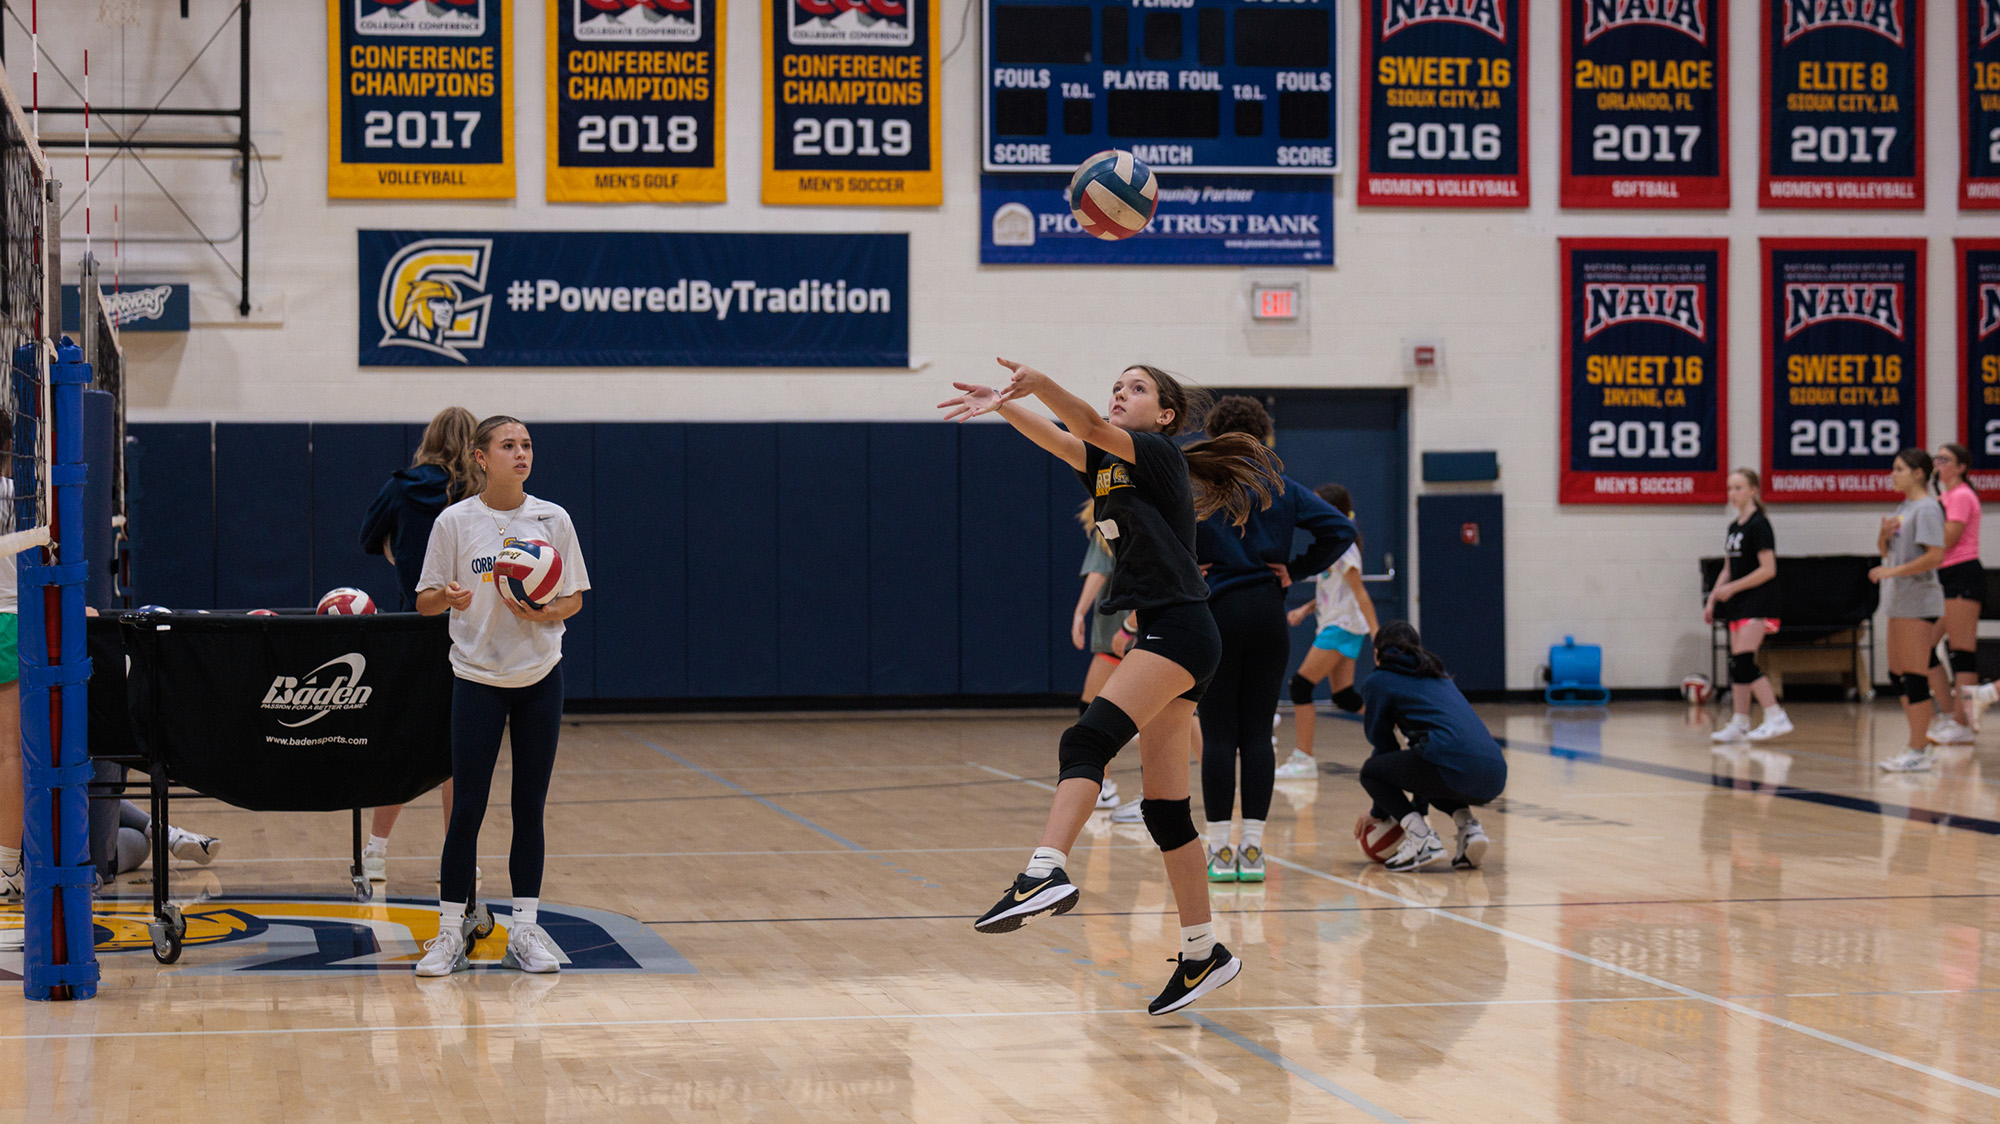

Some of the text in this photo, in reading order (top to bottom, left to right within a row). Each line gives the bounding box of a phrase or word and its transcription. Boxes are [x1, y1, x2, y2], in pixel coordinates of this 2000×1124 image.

[351, 45, 494, 69] CONFERENCE
[568, 50, 709, 74] CONFERENCE
[783, 54, 923, 78] CONFERENCE
[351, 72, 495, 96] CHAMPIONS
[993, 68, 1051, 88] FOULS
[1103, 70, 1223, 90] PLAYER FOUL
[1276, 72, 1332, 92] FOULS
[1378, 56, 1511, 88] SWEET 16
[1575, 59, 1713, 90] 2ND PLACE
[1798, 61, 1889, 91] ELITE 8
[568, 76, 710, 100] CHAMPIONS
[783, 81, 923, 105] CHAMPIONS
[1061, 82, 1096, 98] T.O.L.
[1386, 88, 1501, 110] SIOUX CITY, IA
[1597, 92, 1695, 112] ORLANDO, FL
[1787, 93, 1899, 114] SIOUX CITY, IA
[364, 110, 481, 148] 2017
[578, 115, 698, 152] 2018
[793, 118, 912, 156] 2019
[1387, 122, 1501, 160] 2016
[993, 143, 1051, 163] SCORE
[1131, 145, 1193, 164] MATCH
[1593, 124, 1702, 162] 2017
[1791, 125, 1897, 163] 2017
[1276, 146, 1333, 166] SCORE
[378, 170, 466, 185] VOLLEYBALL
[595, 174, 679, 188] MEN'S GOLF
[799, 177, 905, 192] MEN'S SOCCER
[1369, 178, 1519, 197] WOMEN'S VOLLEYBALL
[1612, 181, 1680, 198] SOFTBALL
[1202, 186, 1255, 203] Partner
[1769, 181, 1916, 199] WOMEN'S VOLLEYBALL
[1157, 214, 1244, 234] TRUST
[1247, 214, 1320, 234] BANK
[506, 278, 891, 321] #PoweredByTradition
[1261, 291, 1293, 317] EXIT
[1585, 283, 1706, 340] NAIA
[1785, 283, 1903, 339] NAIA
[1586, 354, 1704, 386] SWEET 16
[1787, 354, 1902, 384] SWEET 16
[1603, 387, 1686, 409] IRVINE, CA
[1789, 386, 1900, 407] SIOUX CITY, IA
[1588, 420, 1701, 458] 2018
[1790, 419, 1900, 456] 2018
[1595, 476, 1694, 494] MEN'S SOCCER
[1772, 474, 1836, 492] WOMEN'S
[261, 675, 373, 706] Baden
[266, 735, 368, 746] www.badensports.com
